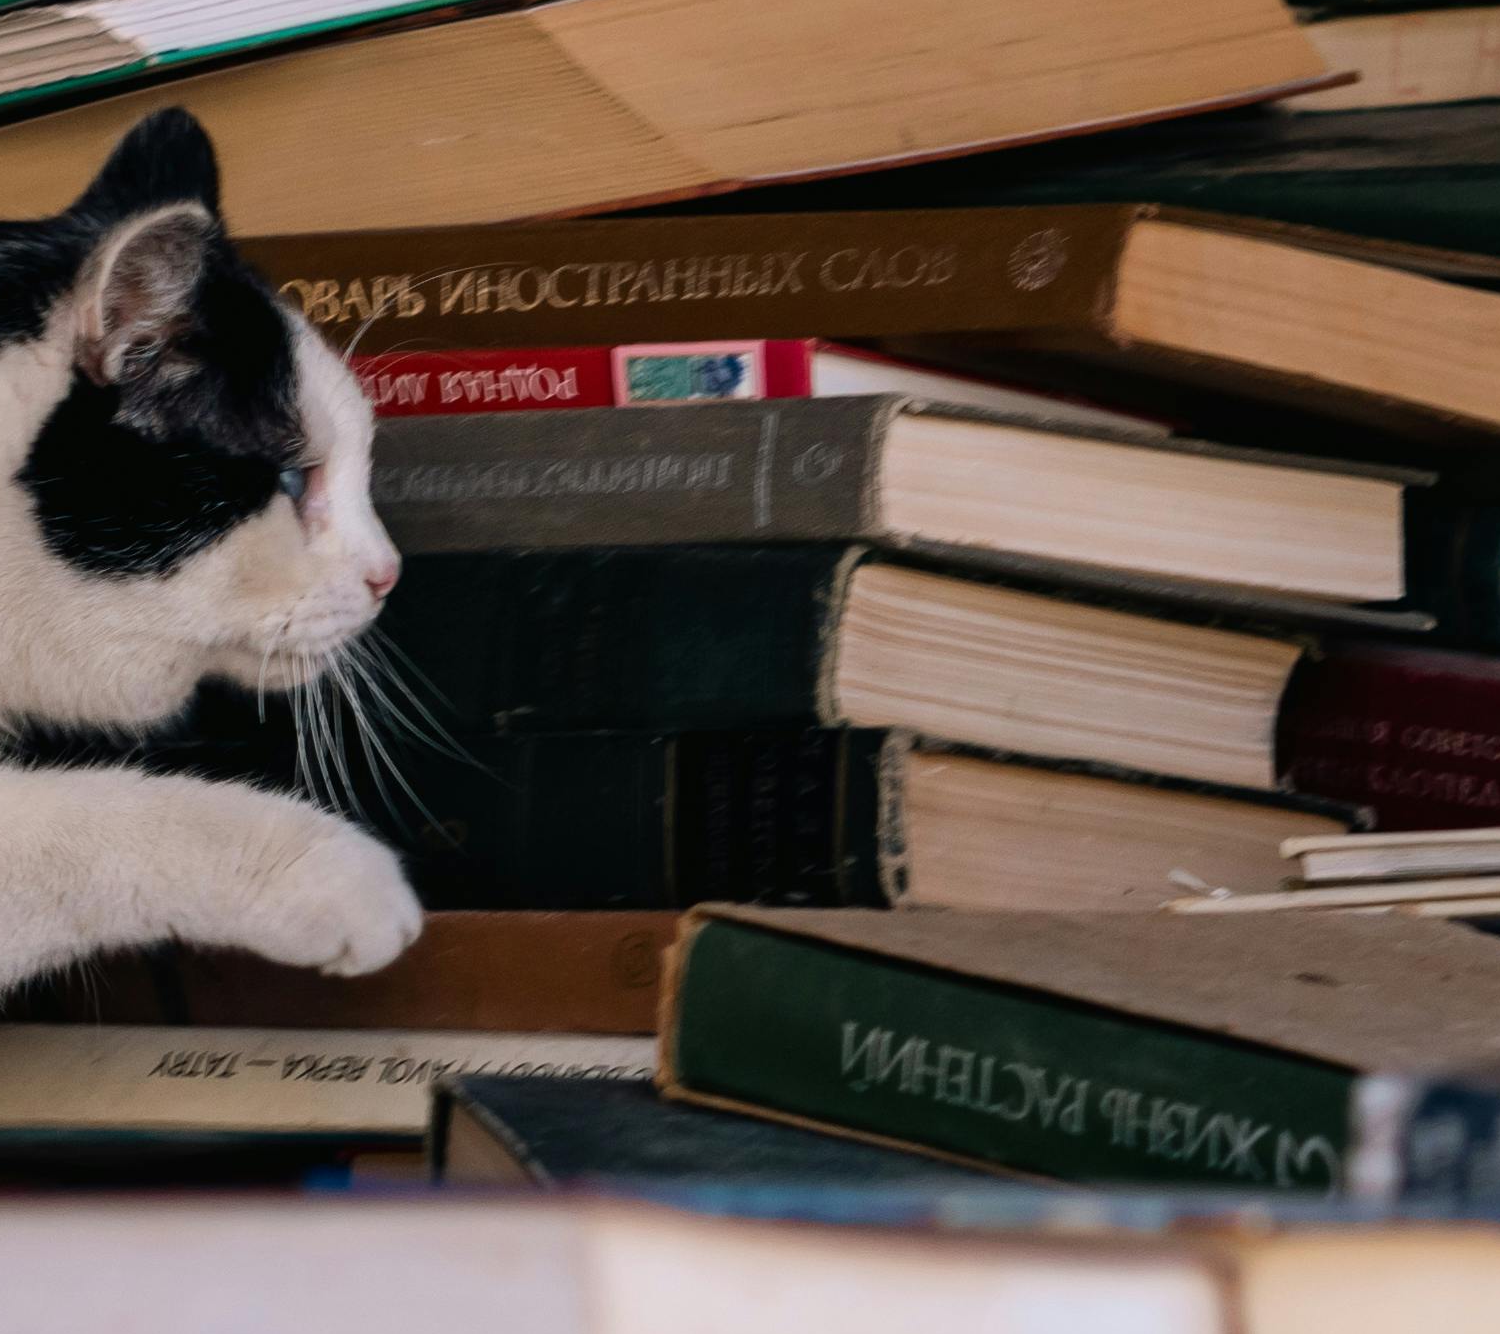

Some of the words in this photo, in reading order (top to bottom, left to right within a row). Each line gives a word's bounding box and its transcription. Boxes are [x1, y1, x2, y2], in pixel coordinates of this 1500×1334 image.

[279, 274, 427, 324] ОВАРЬ
[436, 249, 809, 319] ИНОСТРАННЫХ
[815, 243, 961, 294] СЛОВ
[439, 362, 581, 408] РОДНАЯ
[146, 1049, 245, 1080] TATRY
[839, 1020, 1091, 1136] РАСТЕНИЙ
[1100, 1087, 1273, 1181] ЖИЗНЬ
